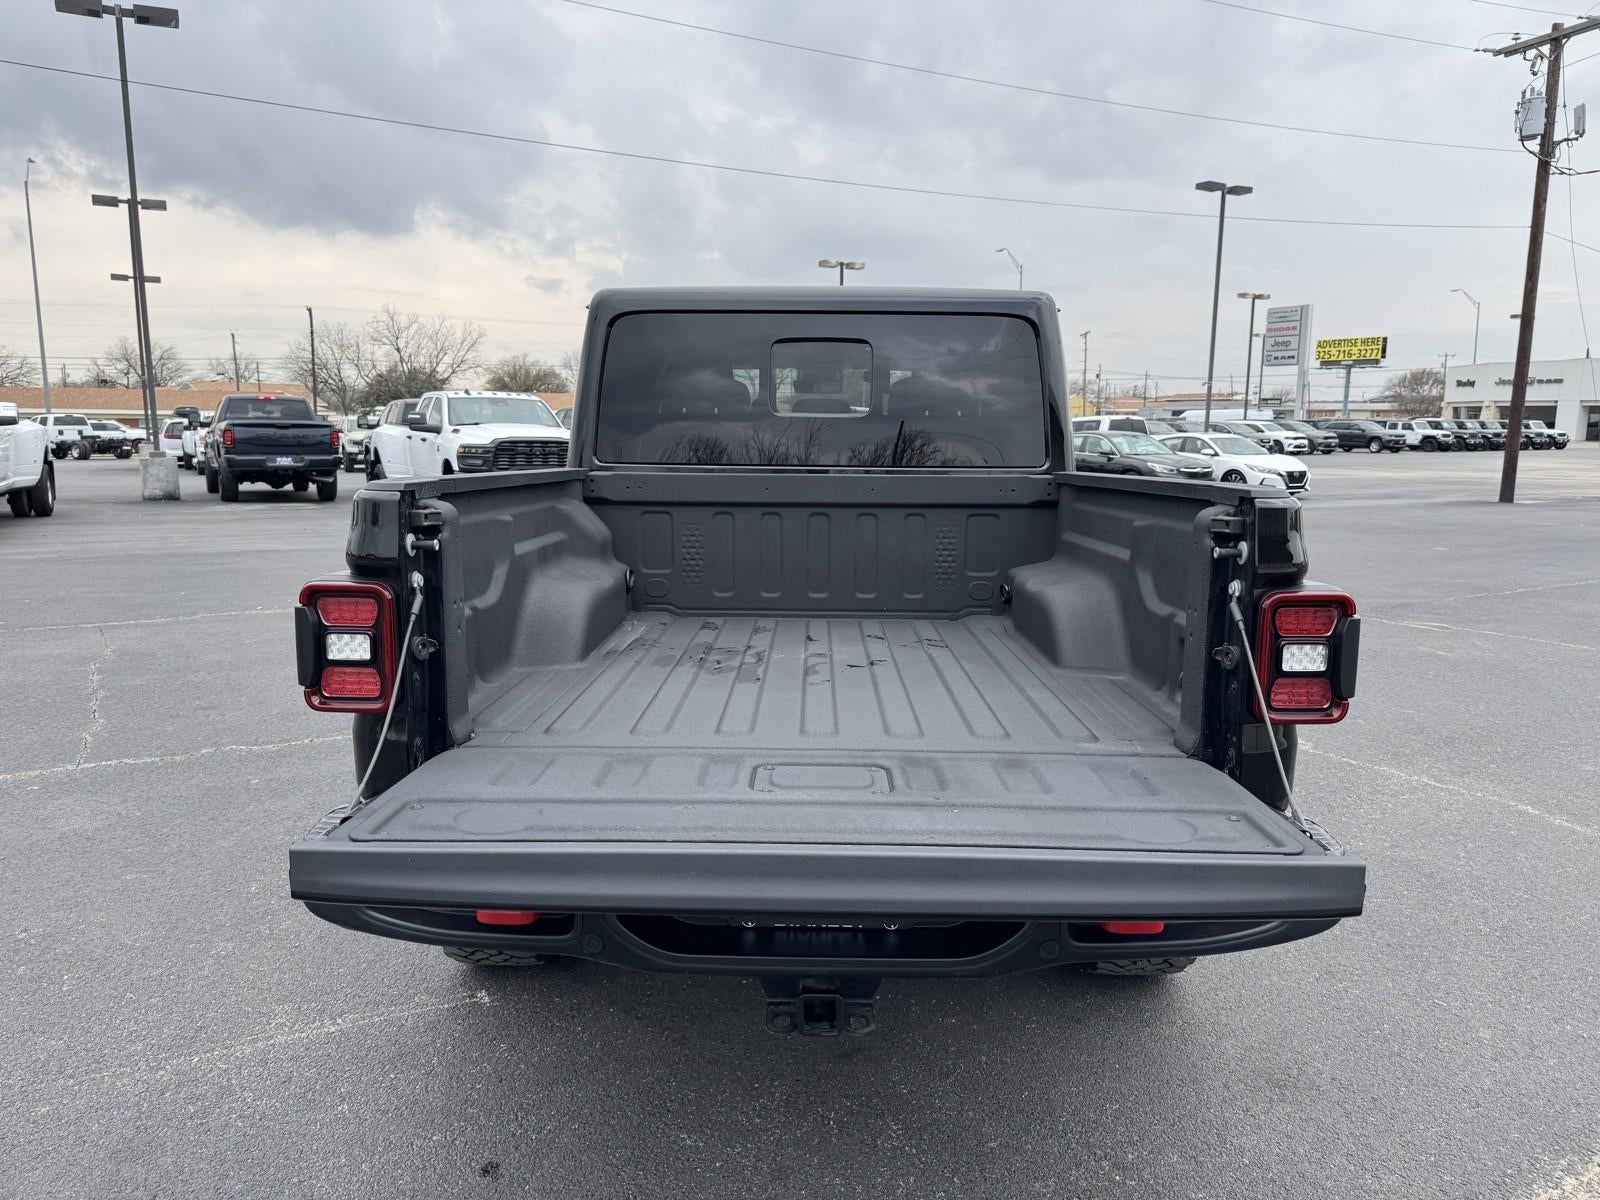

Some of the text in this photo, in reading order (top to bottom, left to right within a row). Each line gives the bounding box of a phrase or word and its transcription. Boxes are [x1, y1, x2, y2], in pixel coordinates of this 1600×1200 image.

[1266, 325, 1298, 333] DODGE
[1270, 338, 1292, 348] Jeep
[1316, 336, 1381, 350] ADVERTISE HERE
[1315, 347, 1380, 360] 325-716-3277
